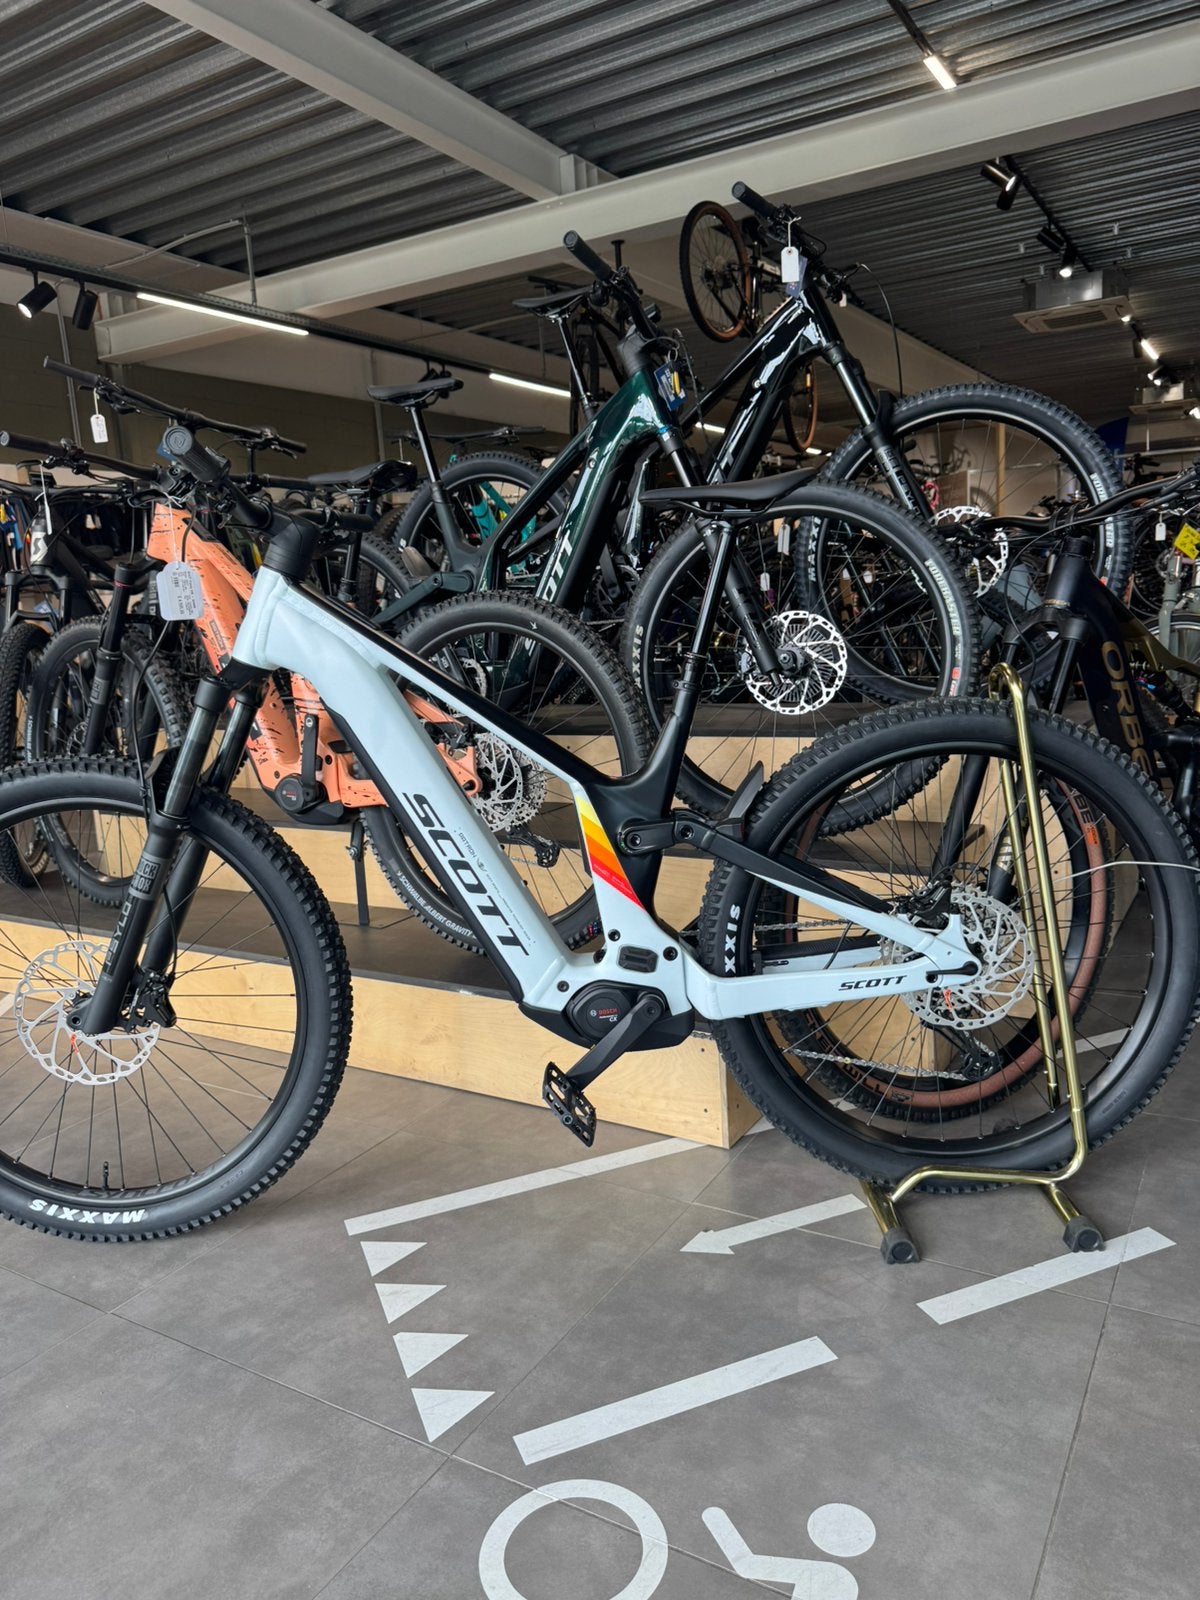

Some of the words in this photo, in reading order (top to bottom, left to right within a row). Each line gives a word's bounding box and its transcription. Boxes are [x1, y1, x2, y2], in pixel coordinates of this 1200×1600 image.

[808, 516, 822, 582] MAXXI
[631, 624, 644, 690] AXXIS
[1101, 640, 1153, 777] ORBE
[400, 875, 427, 907] SCHWALBE
[424, 904, 447, 924] ALBERT
[445, 919, 473, 937] GRAVITY
[402, 792, 530, 956] SCOTT
[724, 904, 740, 974] XXIS
[838, 975, 908, 991] SCOTT
[28, 1198, 146, 1224] MAXXIS
